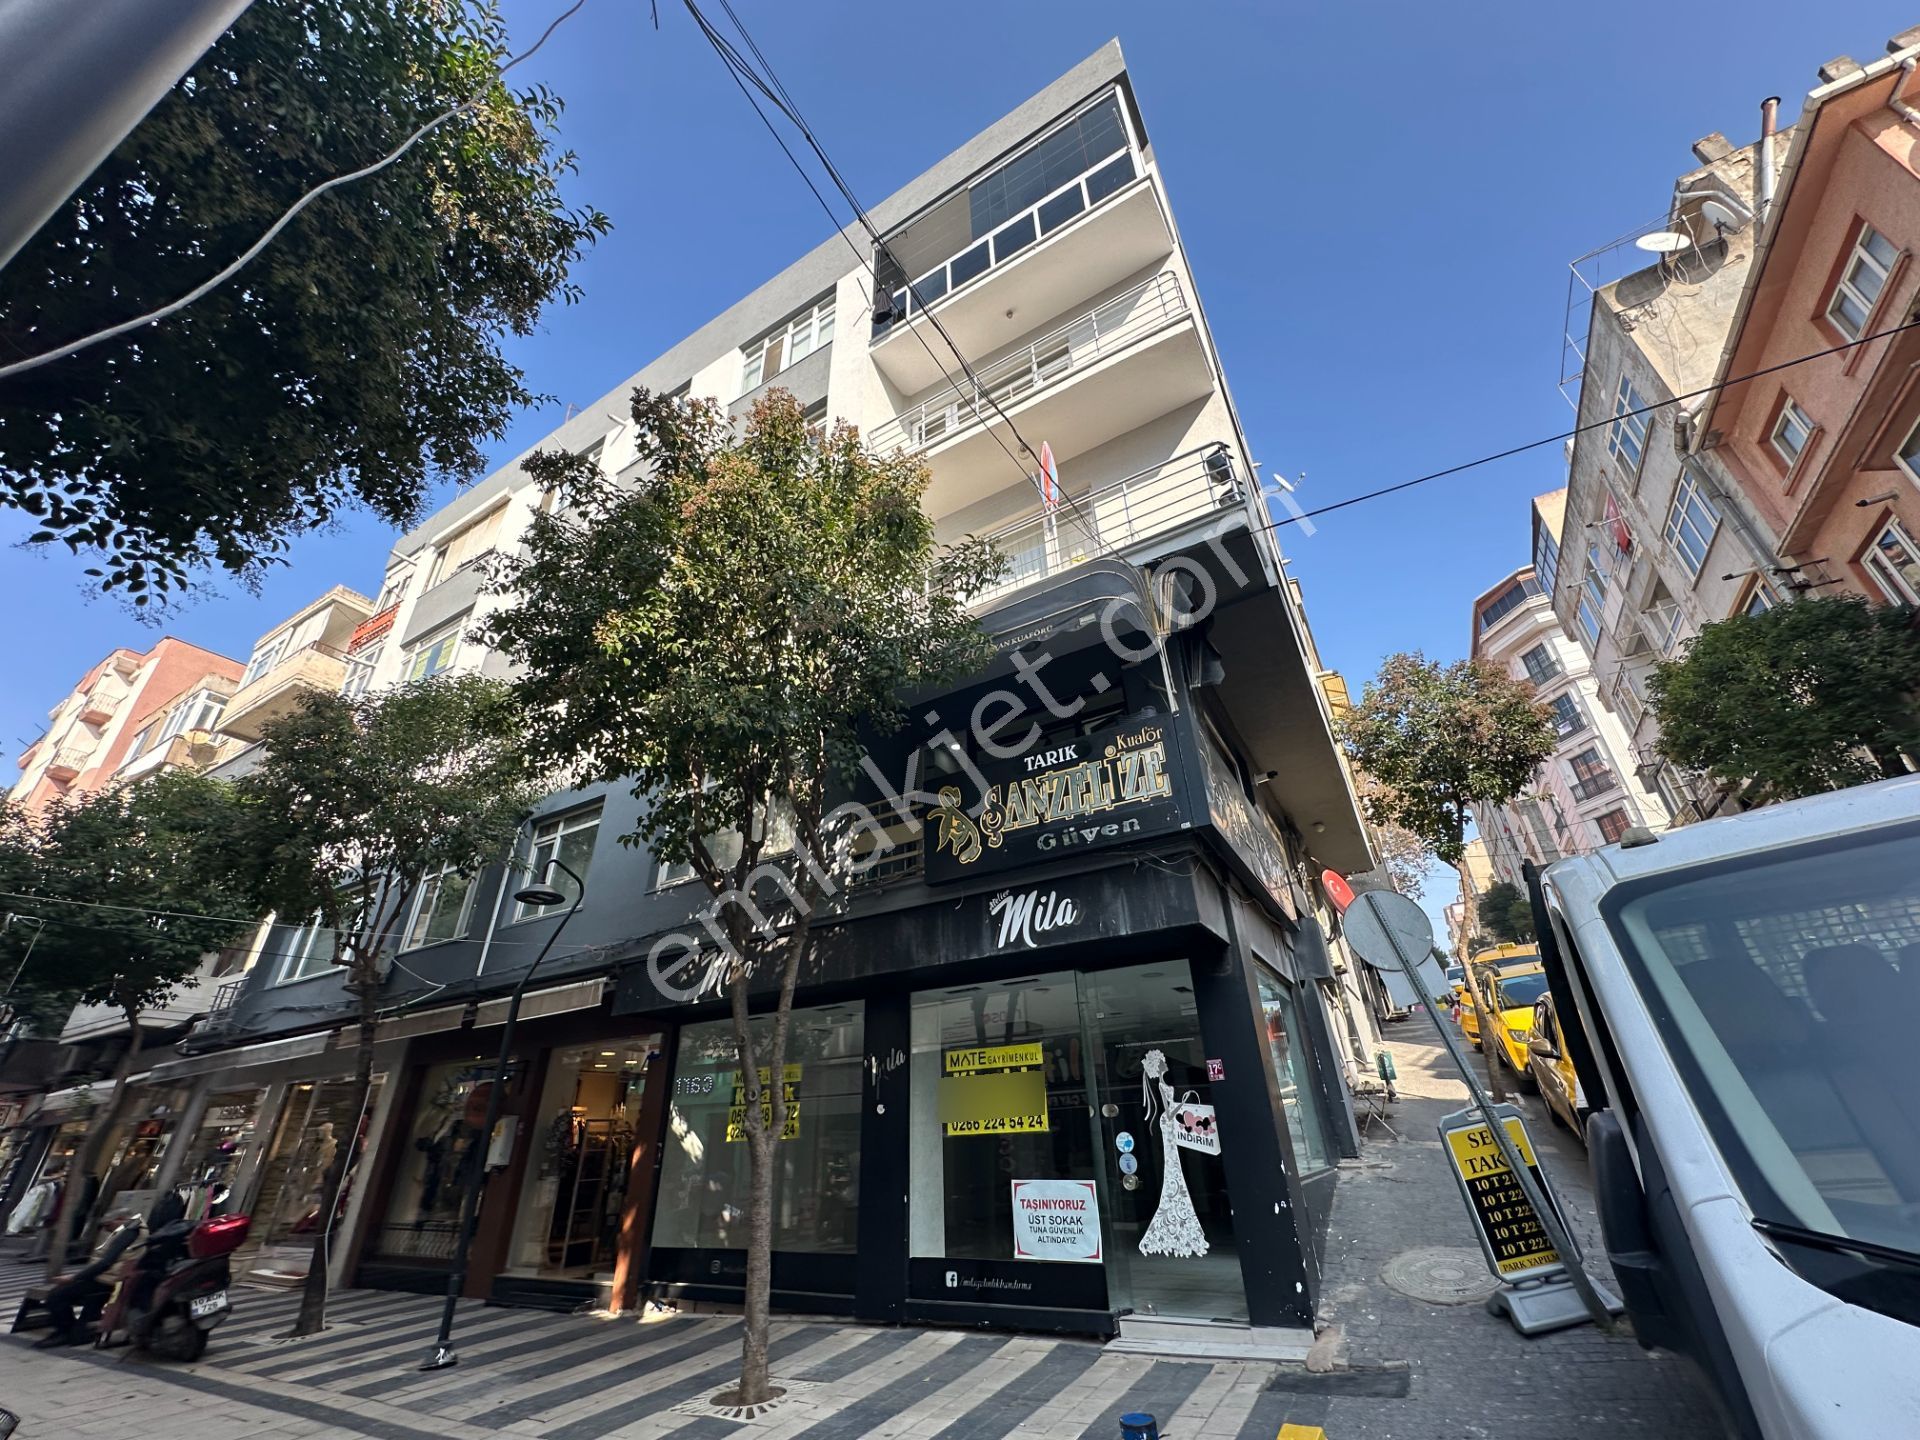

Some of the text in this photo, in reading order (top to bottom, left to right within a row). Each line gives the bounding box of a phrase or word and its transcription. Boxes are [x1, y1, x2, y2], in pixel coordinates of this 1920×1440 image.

[1116, 726, 1163, 747] Kuaför
[1024, 745, 1078, 772] TARIK
[1037, 818, 1140, 851] Güven
[991, 890, 1078, 949] Mila
[949, 1051, 987, 1068] MATE
[984, 1118, 1006, 1130] 224
[1009, 1116, 1025, 1129] 54
[1028, 1114, 1044, 1128] 24
[1467, 1129, 1498, 1149] SE
[1464, 1144, 1528, 1174] TAKİ
[1475, 1179, 1489, 1191] 10
[1490, 1176, 1500, 1187] T
[1020, 1199, 1086, 1212] TAŞINIYORUZ
[1481, 1194, 1496, 1207] 10
[1497, 1192, 1506, 1203] T
[1028, 1213, 1083, 1226] ÜST SOKAK
[1488, 1210, 1502, 1223] 10
[1503, 1208, 1513, 1219] T
[1029, 1225, 1084, 1235] TUNA GÜVENLİK
[1494, 1227, 1509, 1240] 10
[1509, 1224, 1519, 1236] T
[1037, 1235, 1077, 1244] ALTINDAYIZ
[1501, 1243, 1516, 1256] 10
[1517, 1240, 1527, 1252] T
[1502, 1260, 1527, 1272] PARK
